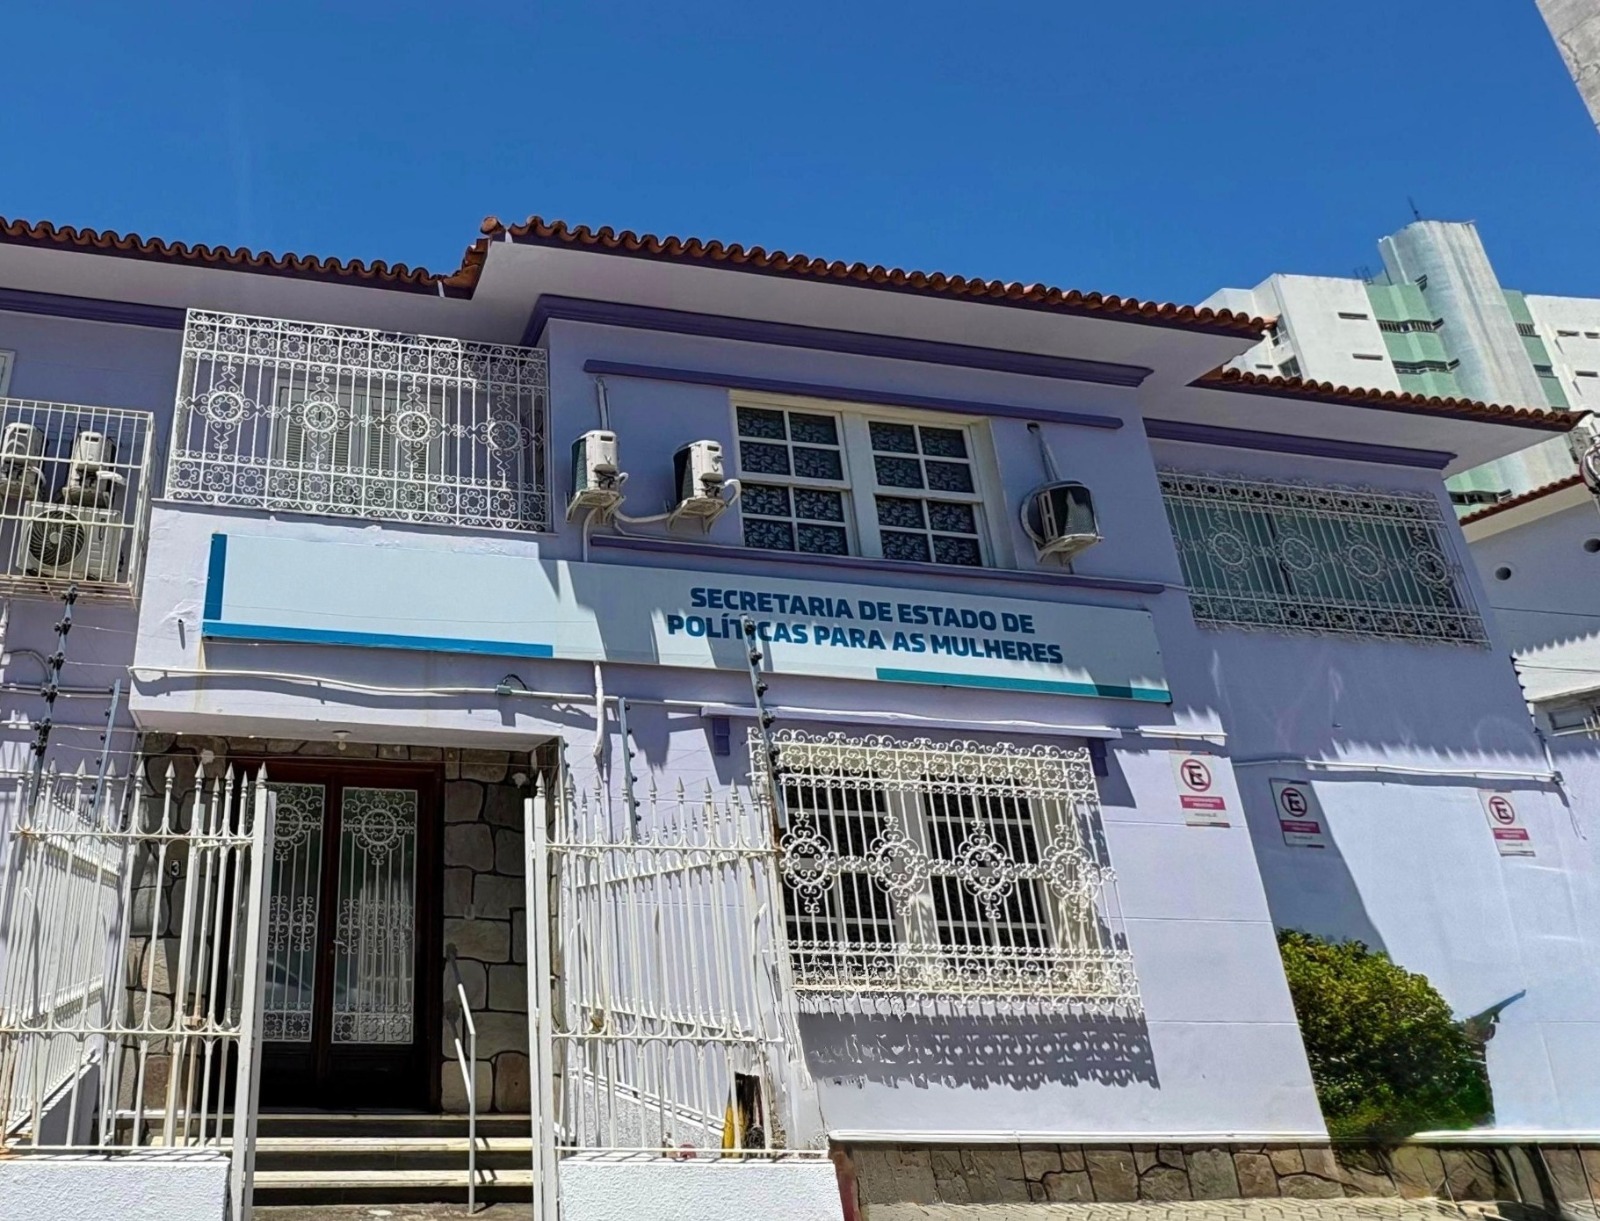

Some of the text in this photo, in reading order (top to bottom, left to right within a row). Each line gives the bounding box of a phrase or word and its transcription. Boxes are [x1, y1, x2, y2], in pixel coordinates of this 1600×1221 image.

[690, 587, 1035, 634] SECRETARIA DE ESTADO DE
[667, 612, 1063, 664] POLÍTCAS PARA AS MULHERES
[171, 861, 179, 876] 3
